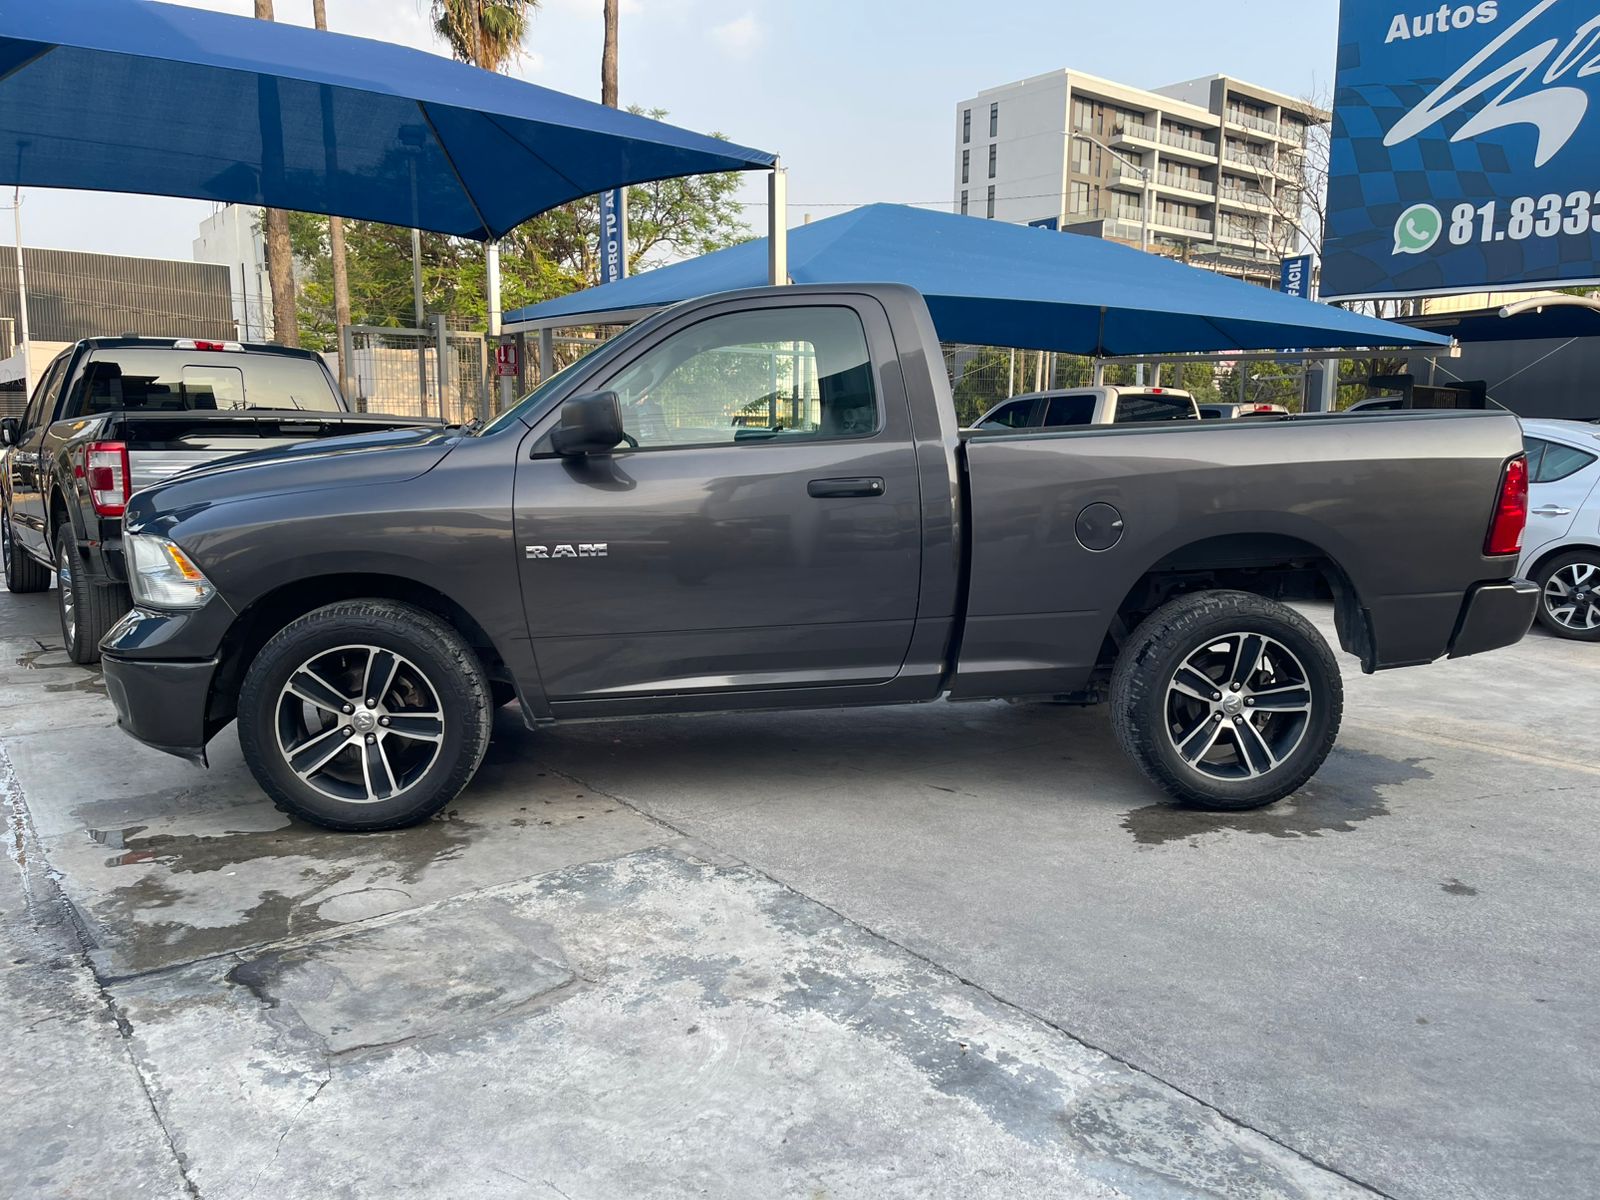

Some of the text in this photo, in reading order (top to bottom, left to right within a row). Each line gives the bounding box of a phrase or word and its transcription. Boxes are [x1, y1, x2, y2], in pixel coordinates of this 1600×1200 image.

[1384, 0, 1498, 44] Autos
[606, 213, 617, 237] TU
[1285, 260, 1301, 296] FÁCIL
[525, 543, 608, 558] RAM
